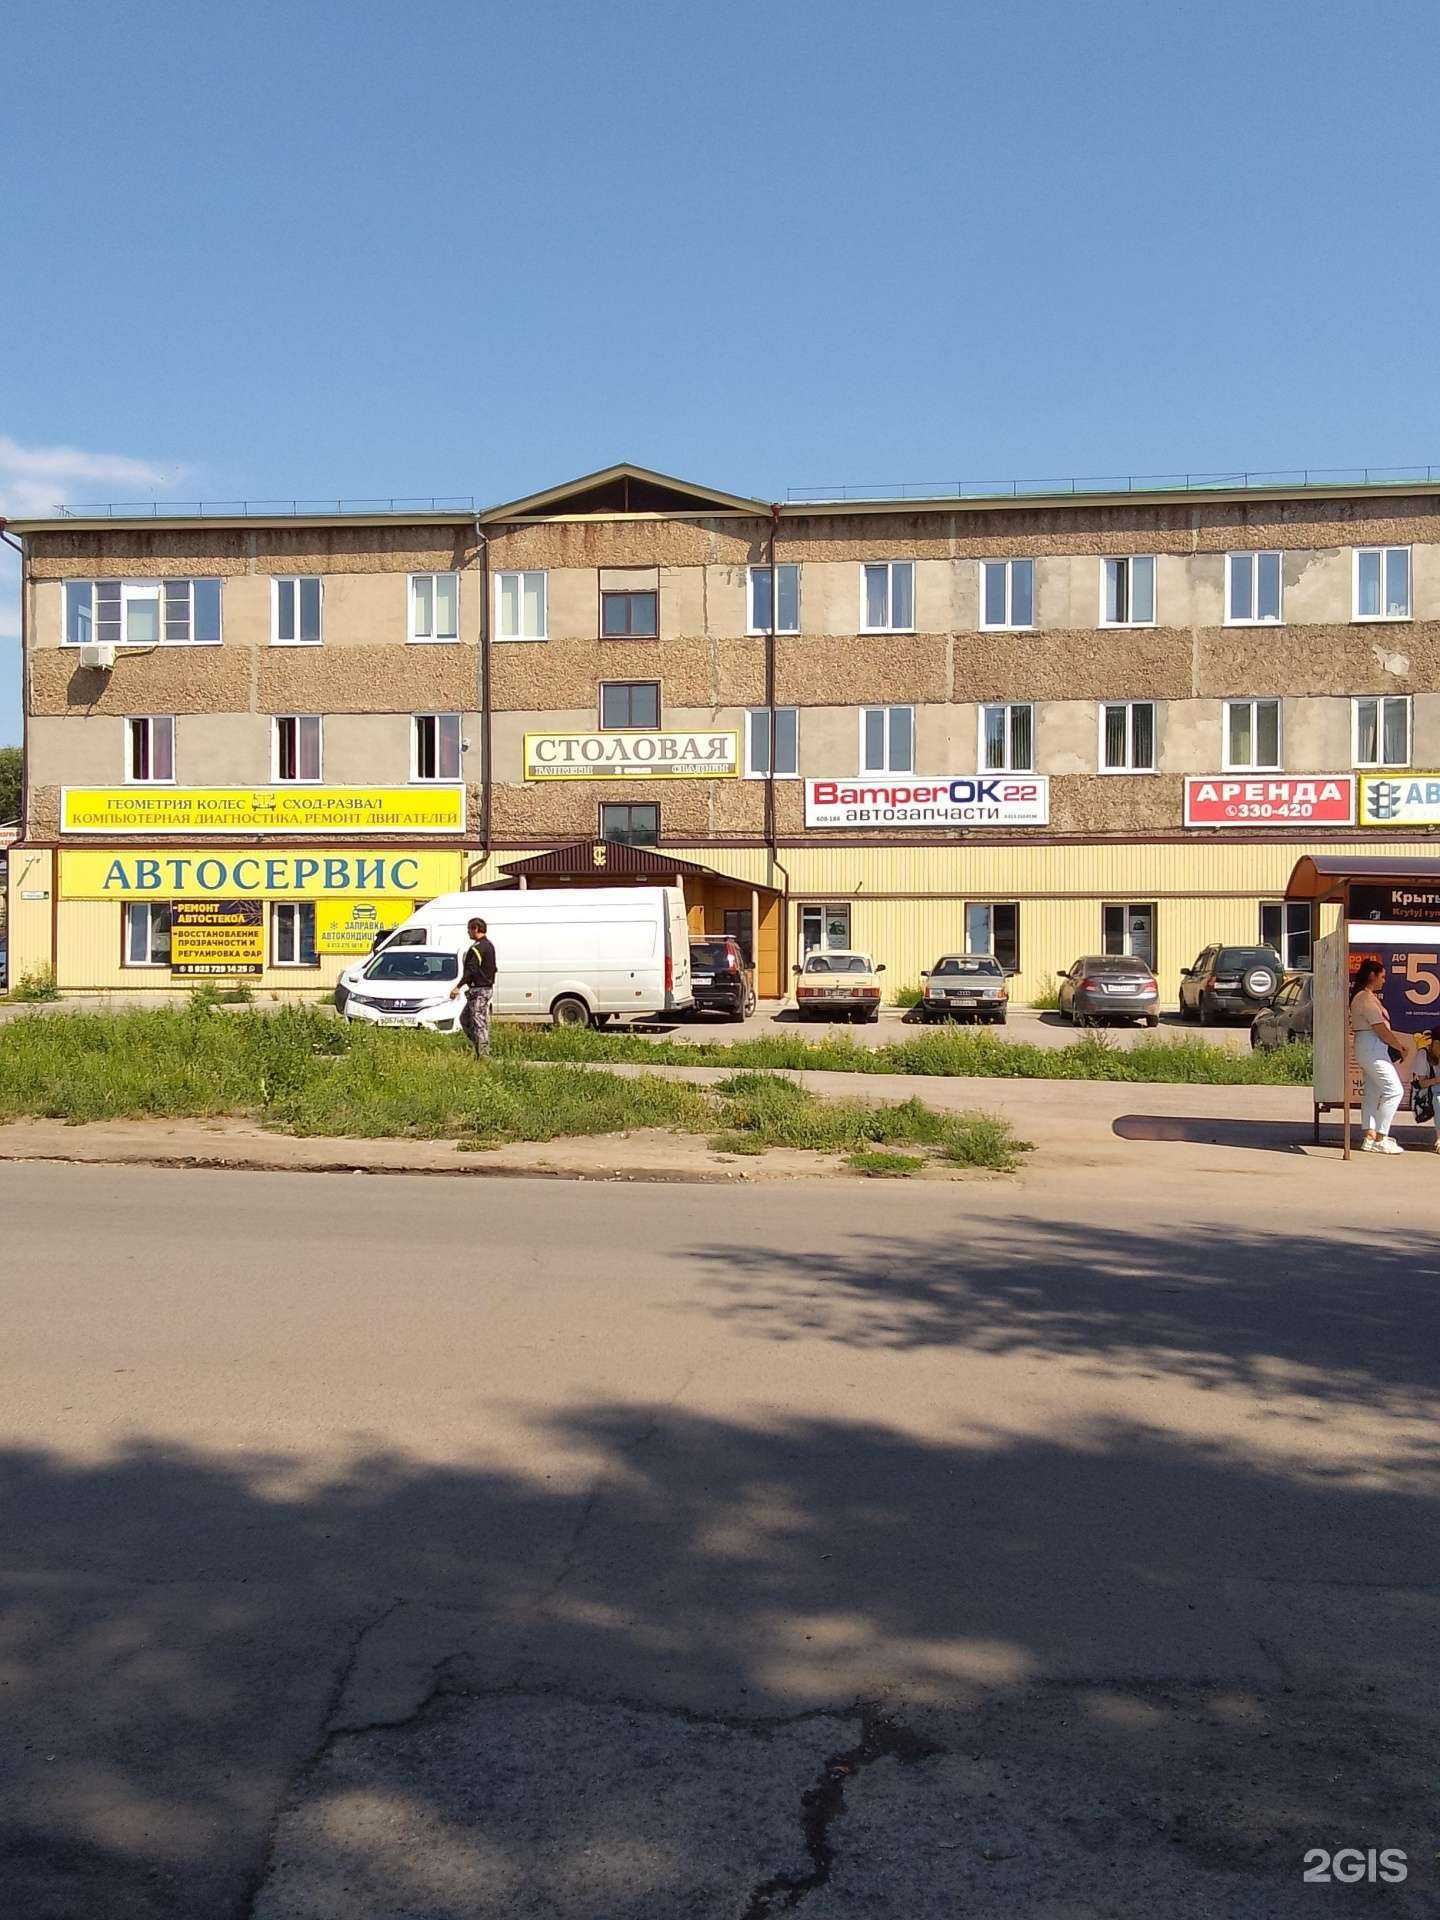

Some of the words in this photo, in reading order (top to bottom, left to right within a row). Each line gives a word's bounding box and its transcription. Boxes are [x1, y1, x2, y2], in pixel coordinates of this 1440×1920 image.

[535, 738, 729, 761] СТОЛОВАЯ
[1196, 783, 1343, 803] АРЕНДА
[107, 799, 192, 810] ГЕОМЕТРИЯ
[197, 799, 246, 810] КОЛЕС
[283, 799, 382, 810] СХОД-РАЗВАЛ
[1238, 803, 1313, 818] 330-420
[73, 813, 190, 824] КОМПЬЮТЕРНАЯ
[194, 813, 302, 825] ДИАГНОСТИКА,
[304, 813, 360, 824] РЕМОНТ
[366, 812, 457, 824] ДВИГАТЕЛЕЙ
[846, 807, 999, 821] автозапчасти
[102, 858, 419, 890] АВТОСЕРВИС
[177, 914, 246, 923] АВТОСТЕКОЛ
[345, 921, 384, 930] ЗАПРАВКА
